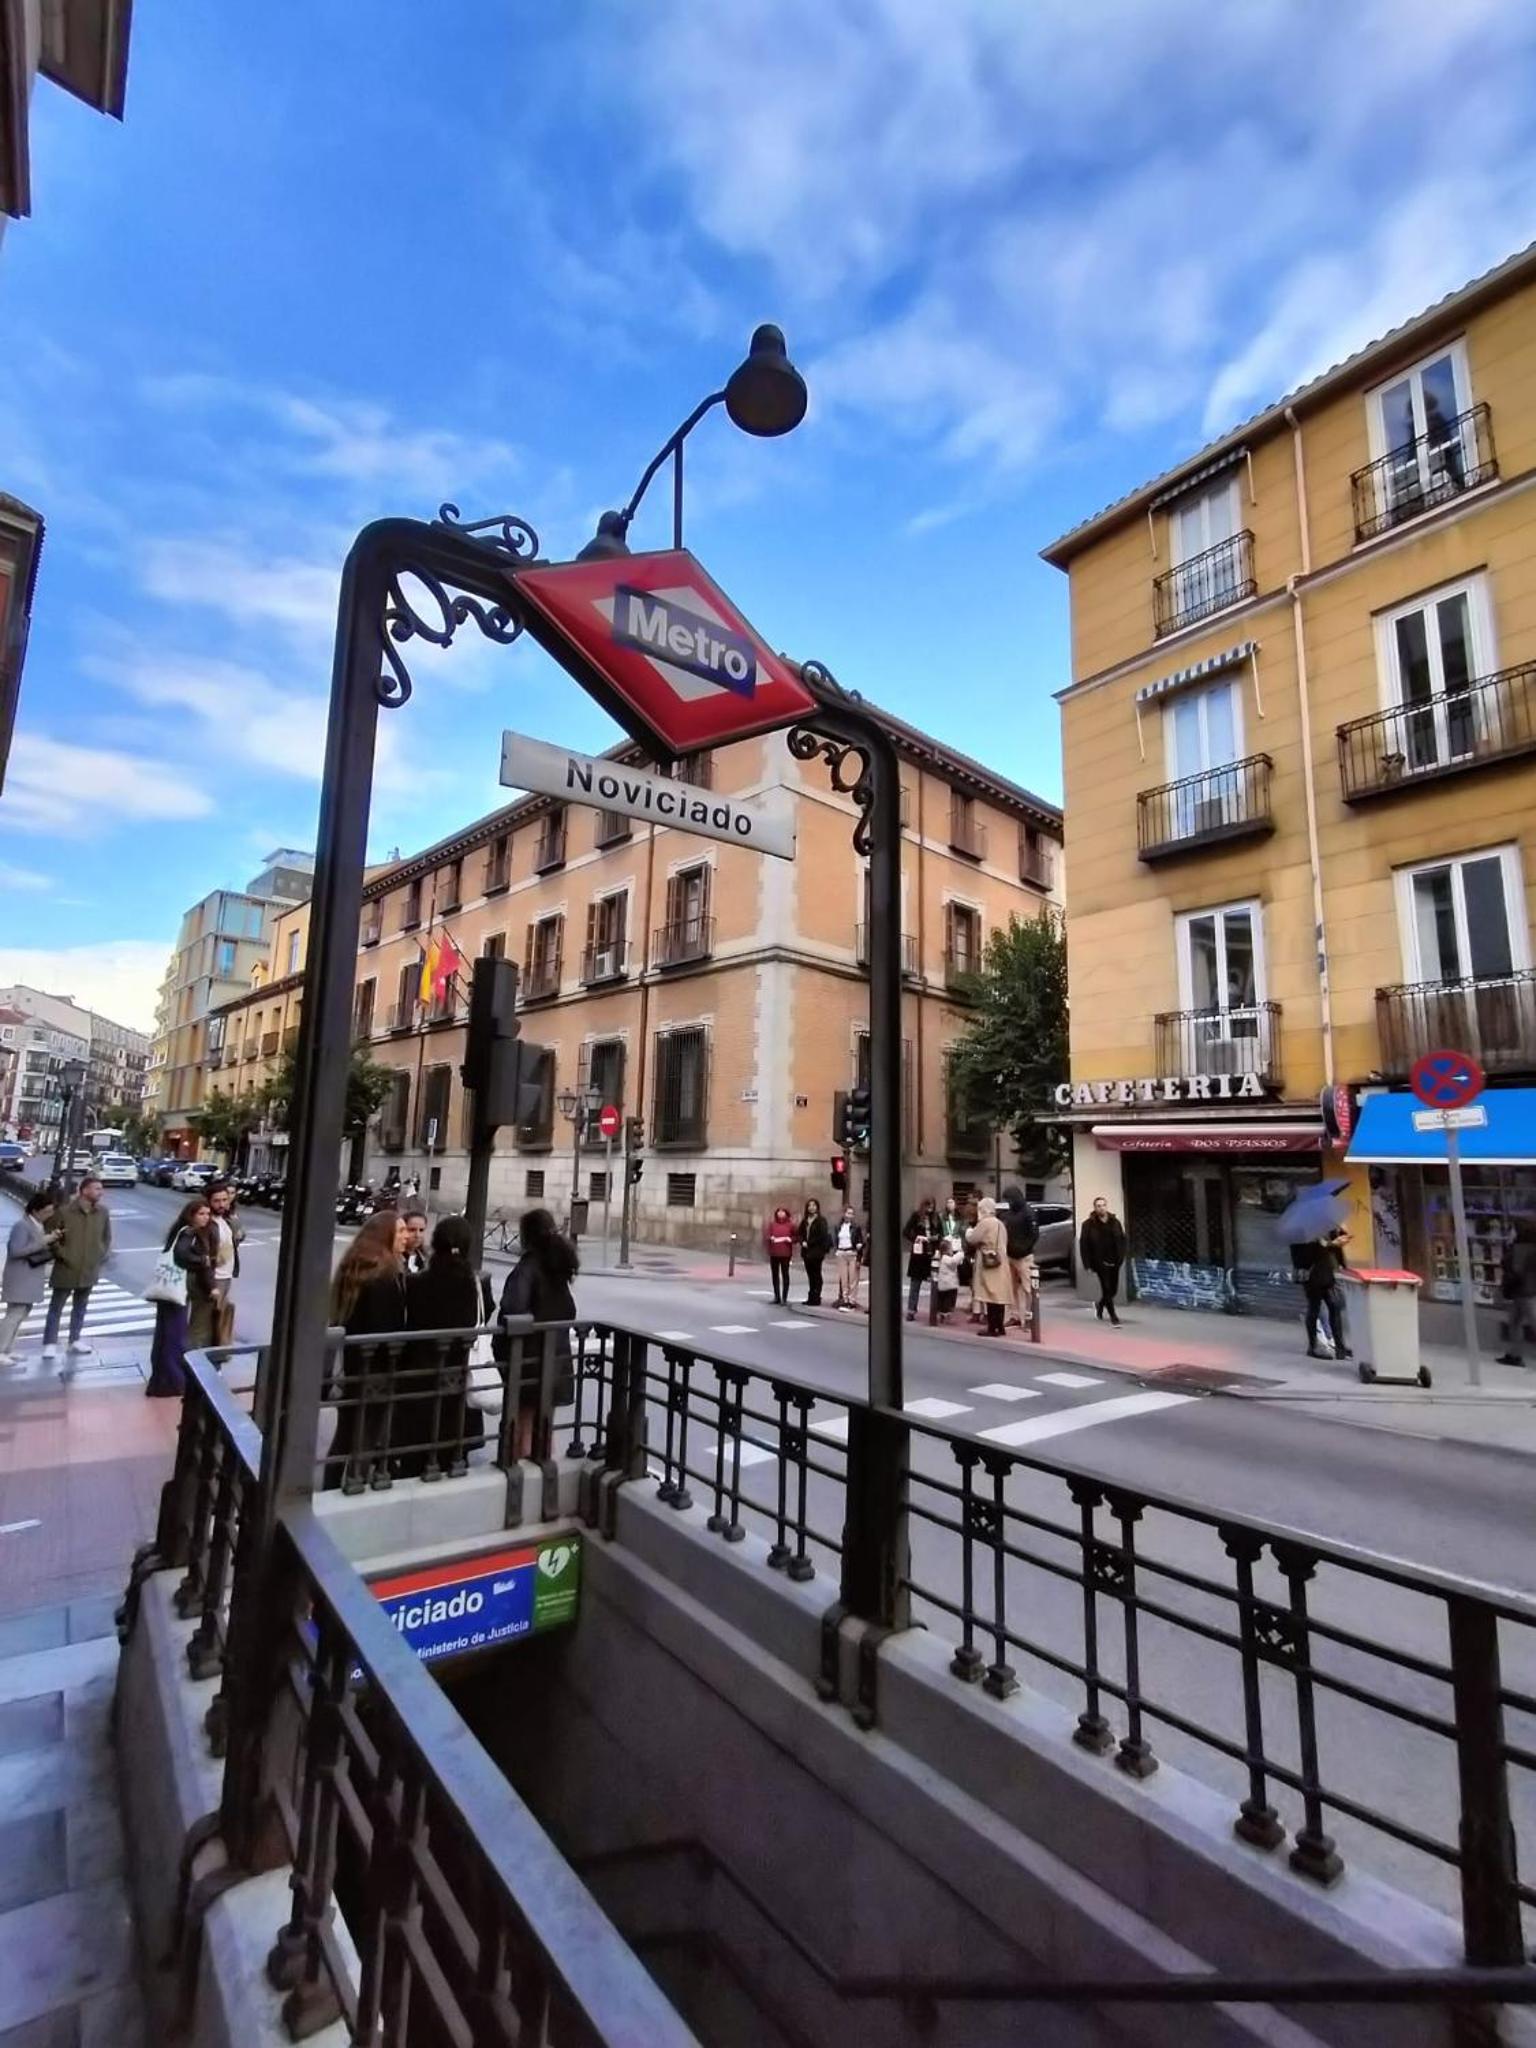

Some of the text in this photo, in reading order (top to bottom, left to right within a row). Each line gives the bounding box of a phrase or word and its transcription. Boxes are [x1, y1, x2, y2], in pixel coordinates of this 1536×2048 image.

[627, 595, 748, 680] Metro
[566, 758, 752, 836] Noviciado
[1055, 1072, 1264, 1105] CAFETERIA
[1191, 1139, 1221, 1148] DOS
[471, 1632, 486, 1645] de
[487, 1620, 530, 1640] Justicia
